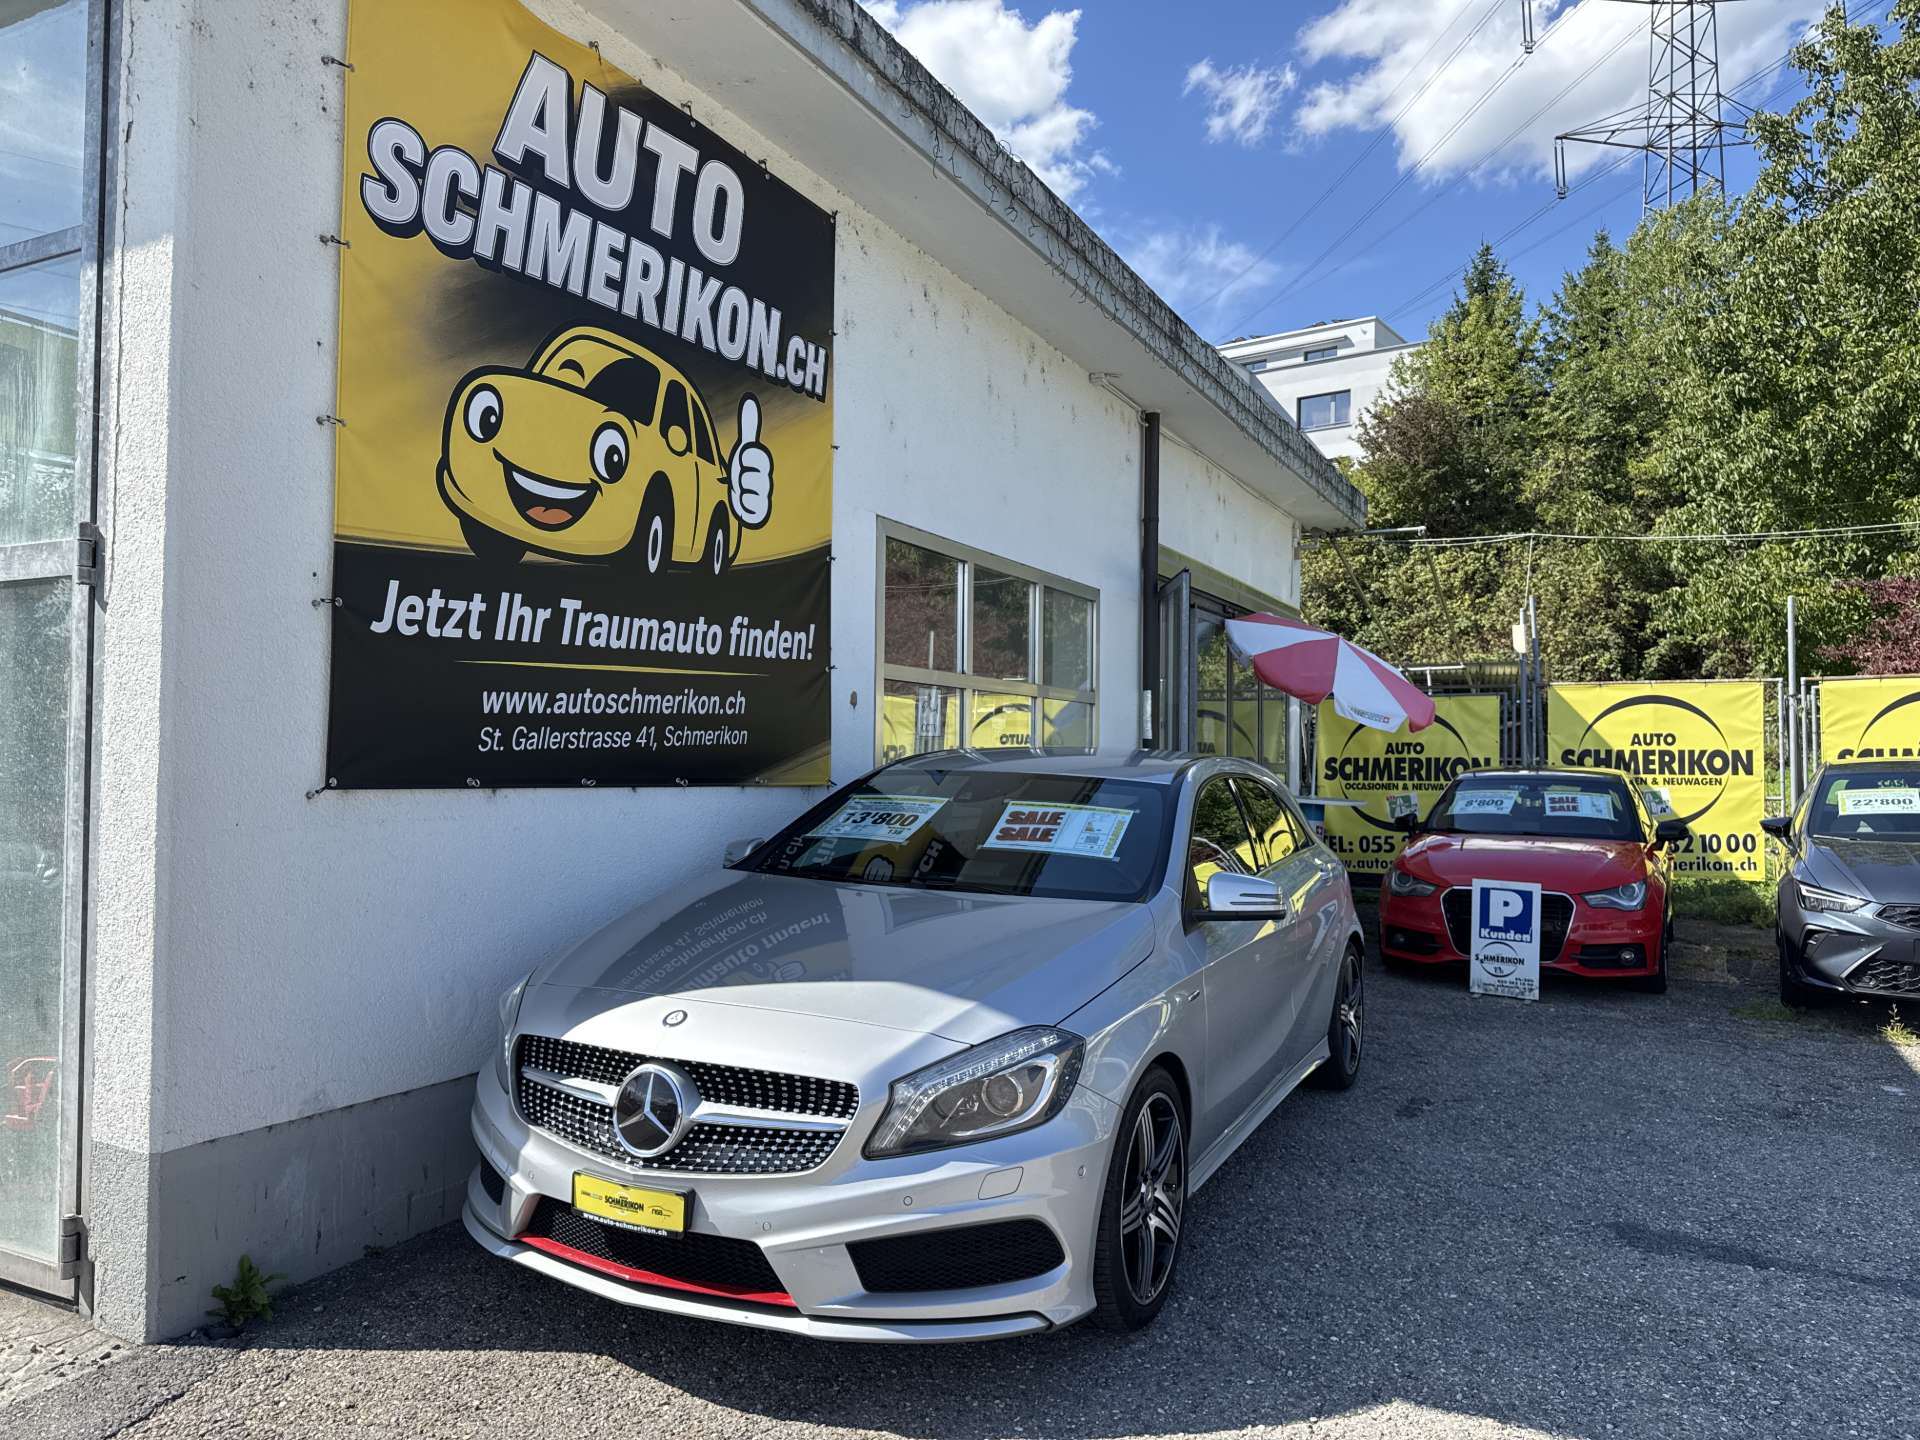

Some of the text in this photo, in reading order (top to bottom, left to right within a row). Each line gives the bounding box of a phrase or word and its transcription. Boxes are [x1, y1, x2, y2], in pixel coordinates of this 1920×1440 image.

[494, 54, 746, 266] AUTO
[362, 119, 827, 397] SCHMERIKON.CH
[370, 579, 816, 661] Jetzt Ihr Traumauto finden!
[481, 687, 746, 716] www.autoschmerikon.ch
[477, 724, 749, 753] St. Gallerstrasse 41, Schmerikon
[1631, 733, 1677, 747] AUTO
[1384, 742, 1425, 755] AUTO
[1344, 782, 1399, 791] OCCASIONEN
[1402, 783, 1409, 791] &
[1651, 777, 1659, 785] &
[1663, 777, 1723, 786] NEUWAGEN
[1851, 798, 1913, 806] 22'800
[843, 811, 919, 827] 13'800
[1005, 810, 1066, 826] SALE
[995, 826, 1058, 843] SALE
[1358, 835, 1396, 853] 055
[1489, 889, 1524, 927] P
[1480, 927, 1531, 942] Kunden
